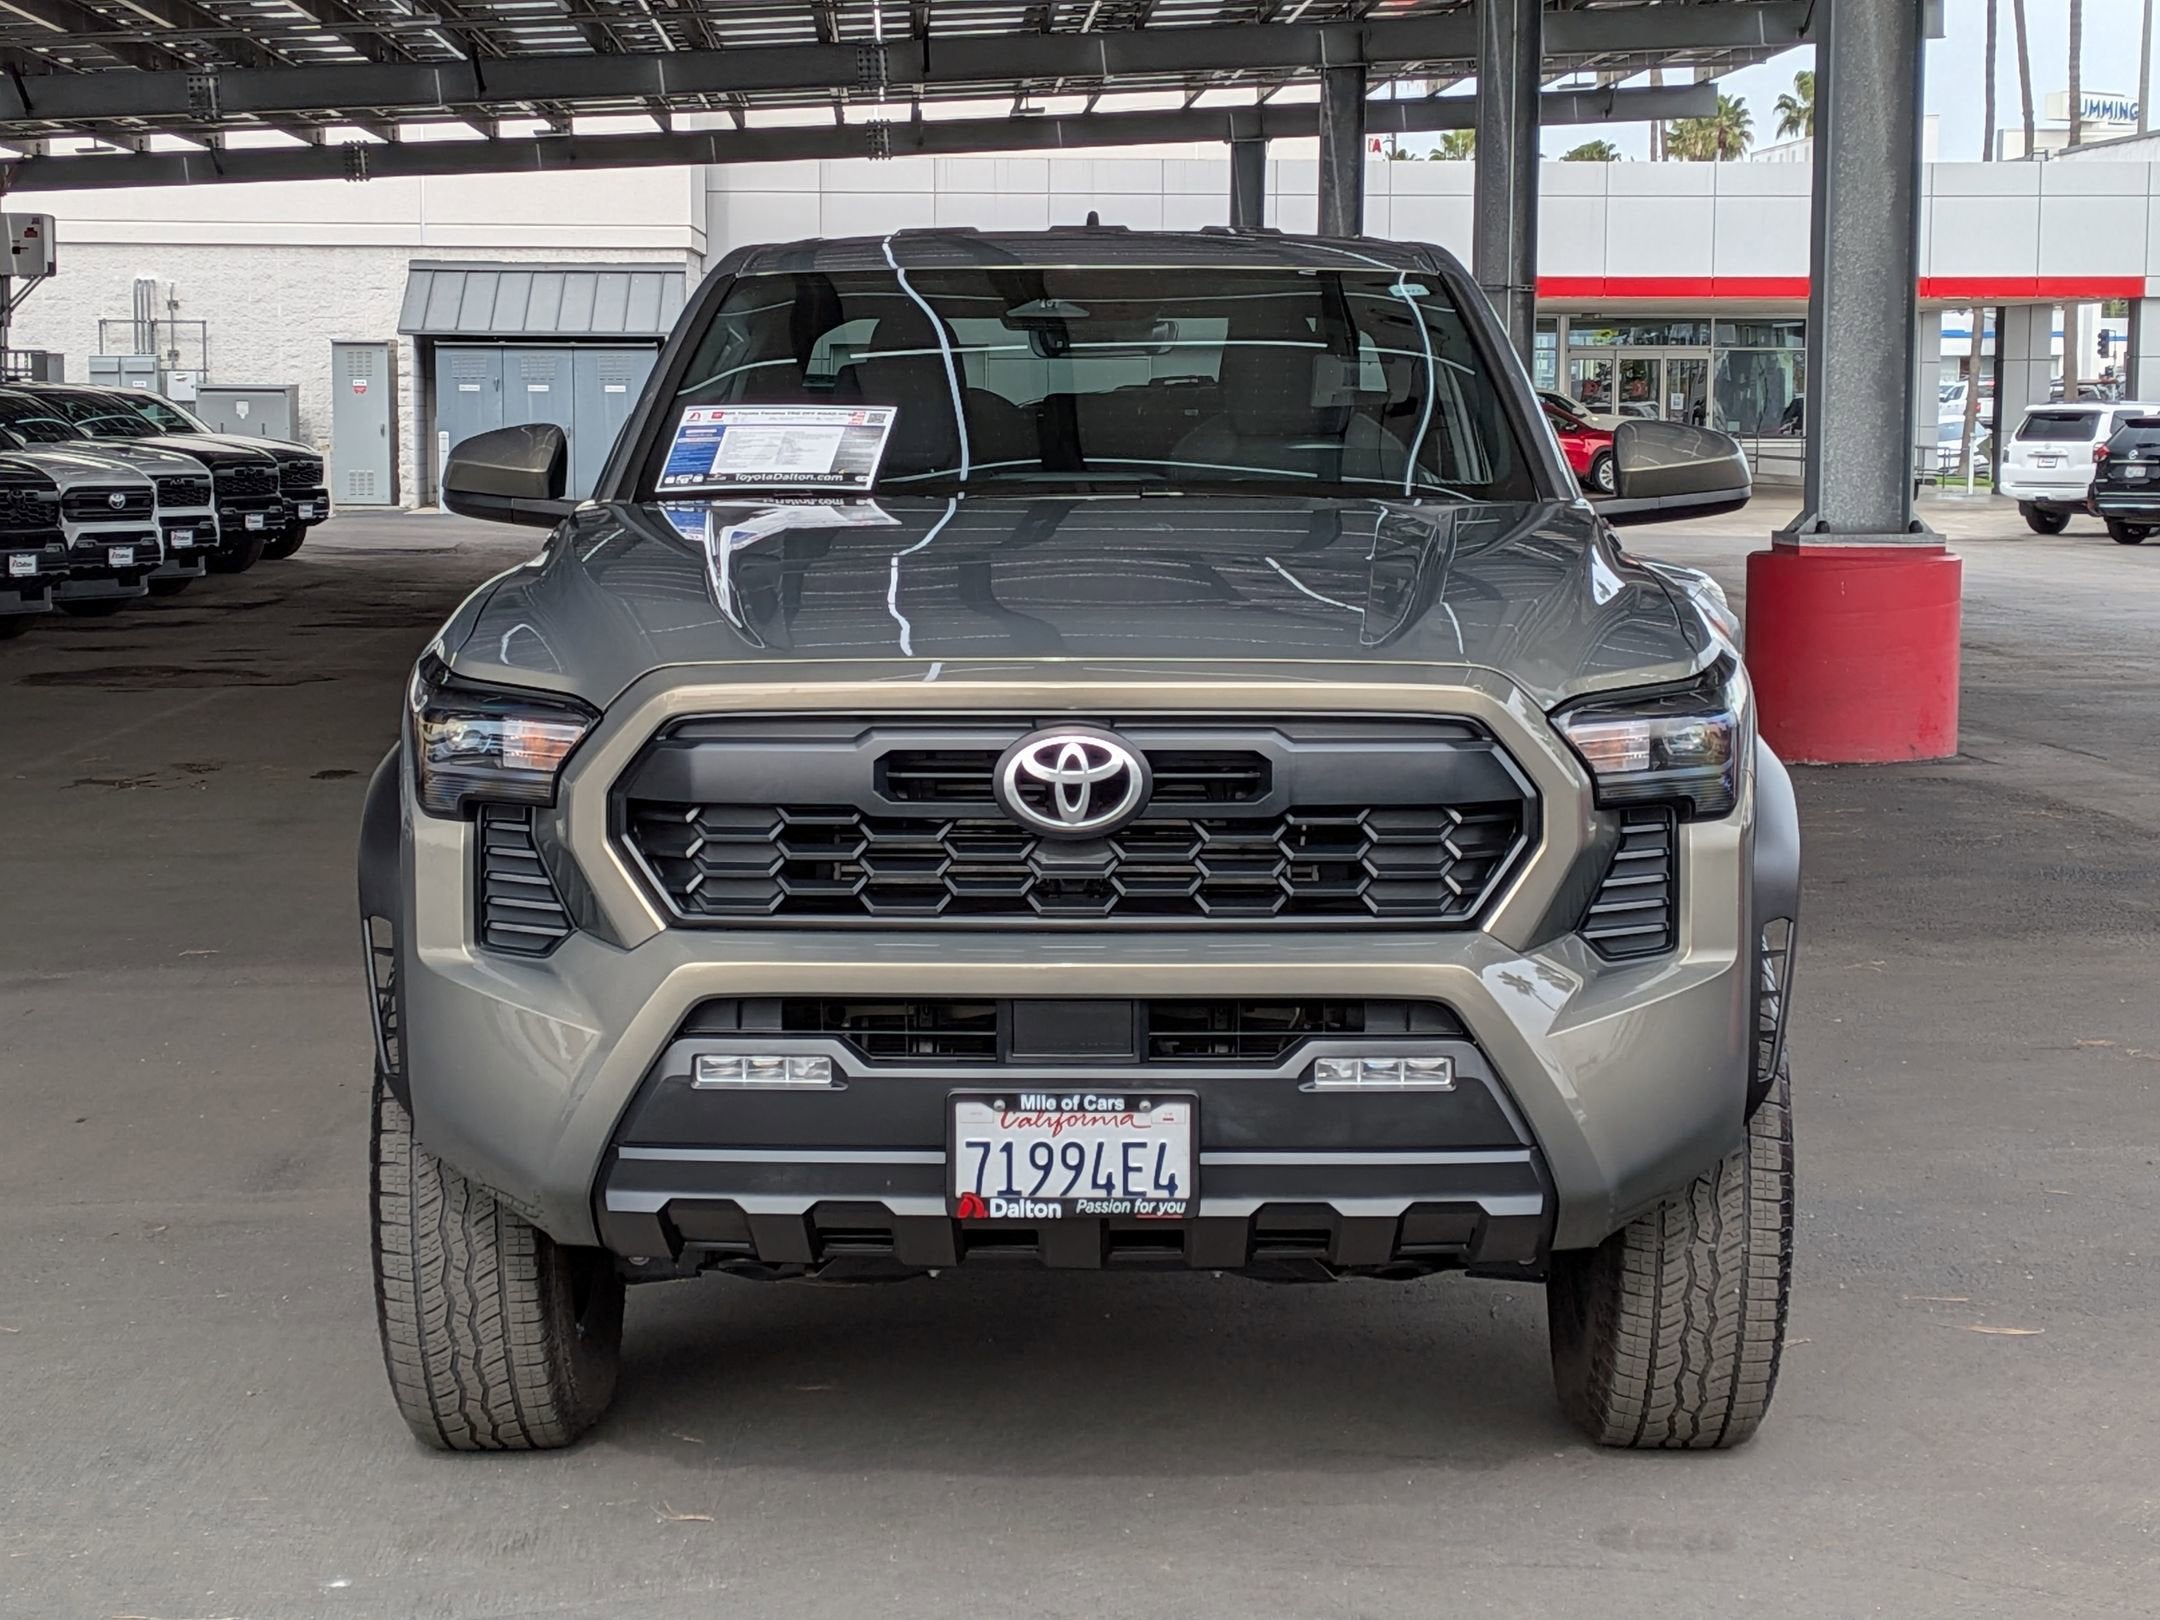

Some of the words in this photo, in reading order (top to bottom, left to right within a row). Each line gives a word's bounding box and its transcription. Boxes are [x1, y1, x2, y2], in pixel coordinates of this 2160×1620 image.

[735, 473, 844, 483] ToyotaDalton.com
[1020, 1094, 1056, 1112] Mile
[1061, 1094, 1081, 1112] of
[1083, 1094, 1126, 1112] Cars
[1000, 1111, 1152, 1138] California
[965, 1141, 1179, 1198] 71994E4
[989, 1198, 1062, 1218] Dalton
[1075, 1198, 1130, 1215] Passion
[1133, 1198, 1154, 1214] for
[1156, 1201, 1187, 1217] you
